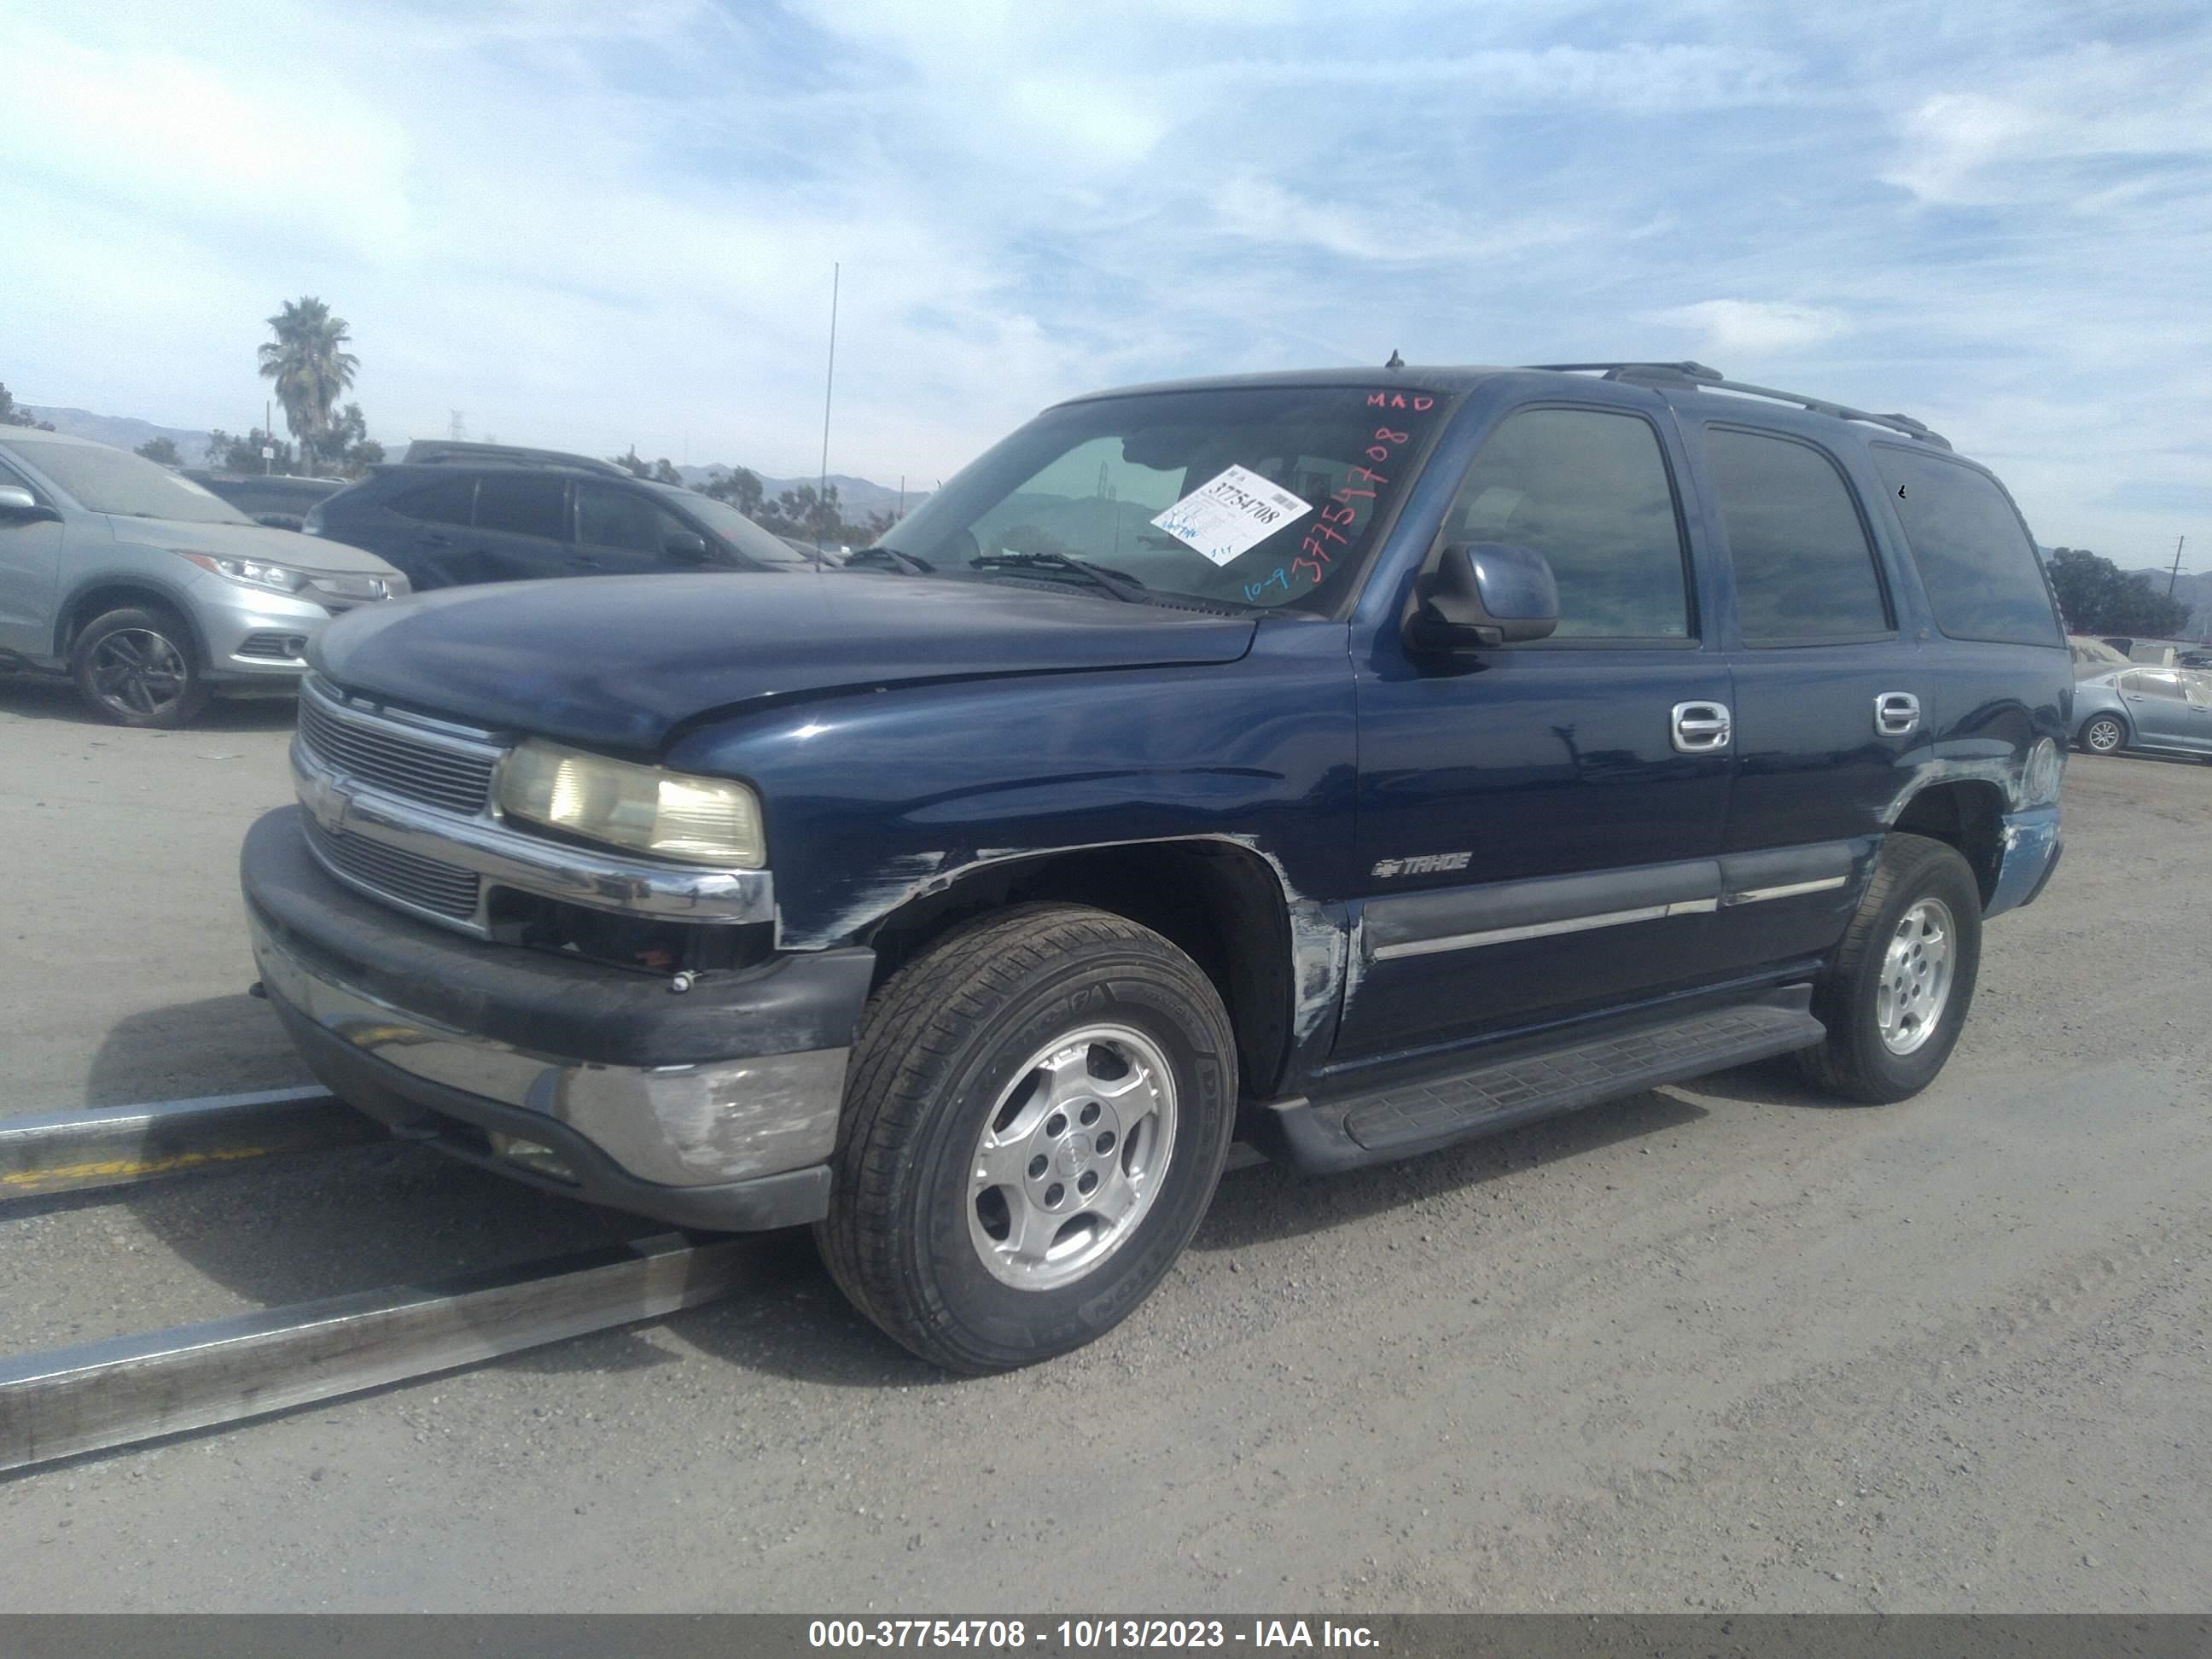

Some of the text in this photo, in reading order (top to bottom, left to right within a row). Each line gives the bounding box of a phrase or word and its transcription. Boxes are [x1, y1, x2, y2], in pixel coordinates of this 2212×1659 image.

[1208, 482, 1280, 525] 37754708
[1291, 428, 1408, 583] 37754708
[1244, 568, 1289, 601] 10-9
[1402, 852, 1474, 874] TAHOE
